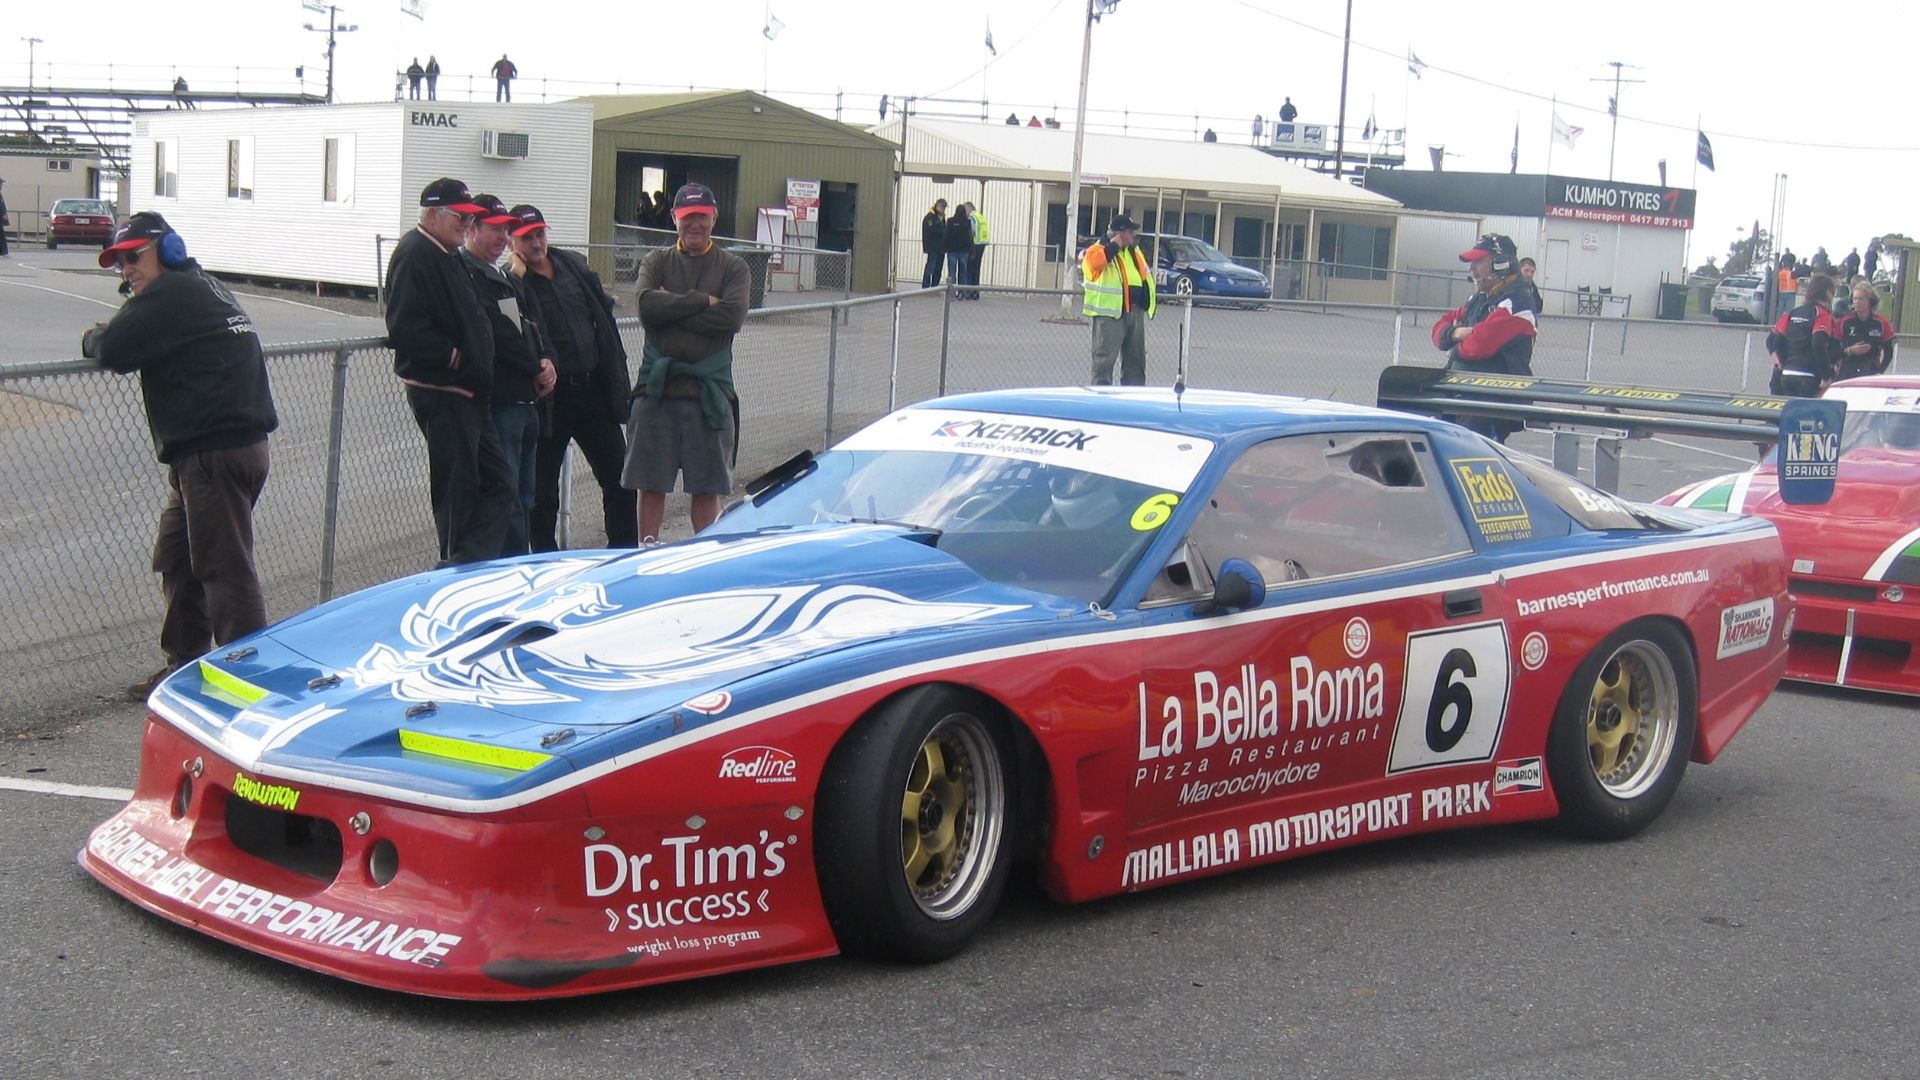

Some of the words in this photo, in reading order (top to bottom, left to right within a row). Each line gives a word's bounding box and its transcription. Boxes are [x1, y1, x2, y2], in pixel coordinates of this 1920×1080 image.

[411, 111, 458, 128] EMAC
[1565, 184, 1617, 206] KUMHO
[1620, 190, 1661, 211] TYRES
[1551, 207, 1573, 217] ACM
[1575, 209, 1626, 222] Motorsport
[1630, 215, 1652, 224] 0417
[1654, 217, 1670, 226] 897
[1672, 219, 1688, 228] 913
[967, 420, 1099, 451] KERRICK
[1459, 465, 1514, 504] Fads
[1784, 466, 1837, 477] SPRINGS
[1130, 493, 1180, 532] 6
[1475, 502, 1521, 515] DESIGNS
[1516, 569, 1710, 617] barnesperformance.com.au
[1138, 682, 1183, 761] La
[1194, 663, 1278, 750] Bella
[1290, 655, 1384, 732] Roma
[1425, 647, 1478, 753] 6
[719, 750, 796, 778] Redline
[1135, 758, 1209, 788] Pizza
[1229, 723, 1381, 767] Restaurant
[233, 772, 300, 810] REVOLUTION
[1496, 768, 1539, 784] CHAMPION
[1121, 829, 1239, 887] MALLALA
[1249, 793, 1412, 857] MOTORSPORT
[1422, 781, 1491, 821] PARK
[584, 844, 660, 897] Dr.
[89, 818, 168, 877] BARNES
[145, 857, 215, 904] HIGH
[198, 879, 463, 969] PERFORMANCE
[626, 890, 751, 930] success
[626, 937, 672, 956] weight
[674, 936, 700, 950] loss
[703, 930, 761, 949] program
